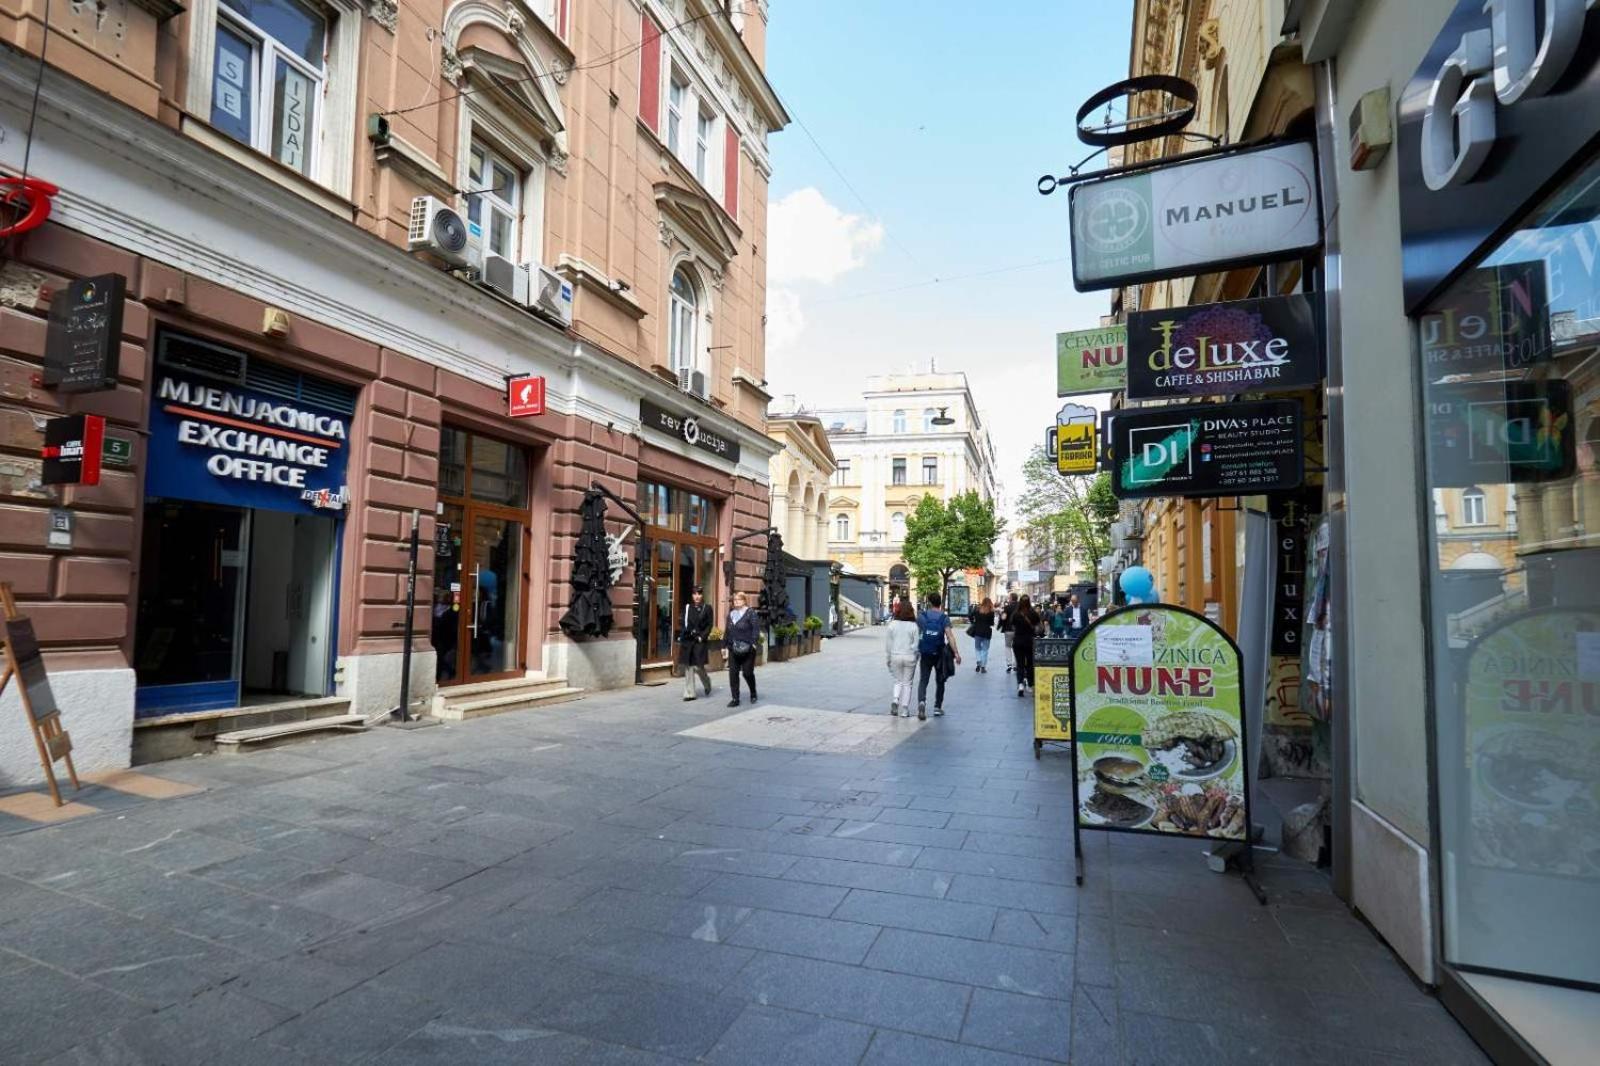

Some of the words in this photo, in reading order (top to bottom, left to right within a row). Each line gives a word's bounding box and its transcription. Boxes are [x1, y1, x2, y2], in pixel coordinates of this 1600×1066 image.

[1166, 186, 1304, 226] MANUEL
[1155, 374, 1193, 387] CAFFE
[1195, 374, 1204, 384] &
[1207, 370, 1252, 383] SHISHA
[1254, 367, 1281, 379] BAR
[1252, 415, 1294, 427] PLACE
[111, 442, 121, 453] 5
[177, 420, 328, 468] EXCHANGE
[1143, 440, 1178, 467] DI
[206, 454, 307, 488] OFFICE
[1096, 665, 1215, 698] NUNE
